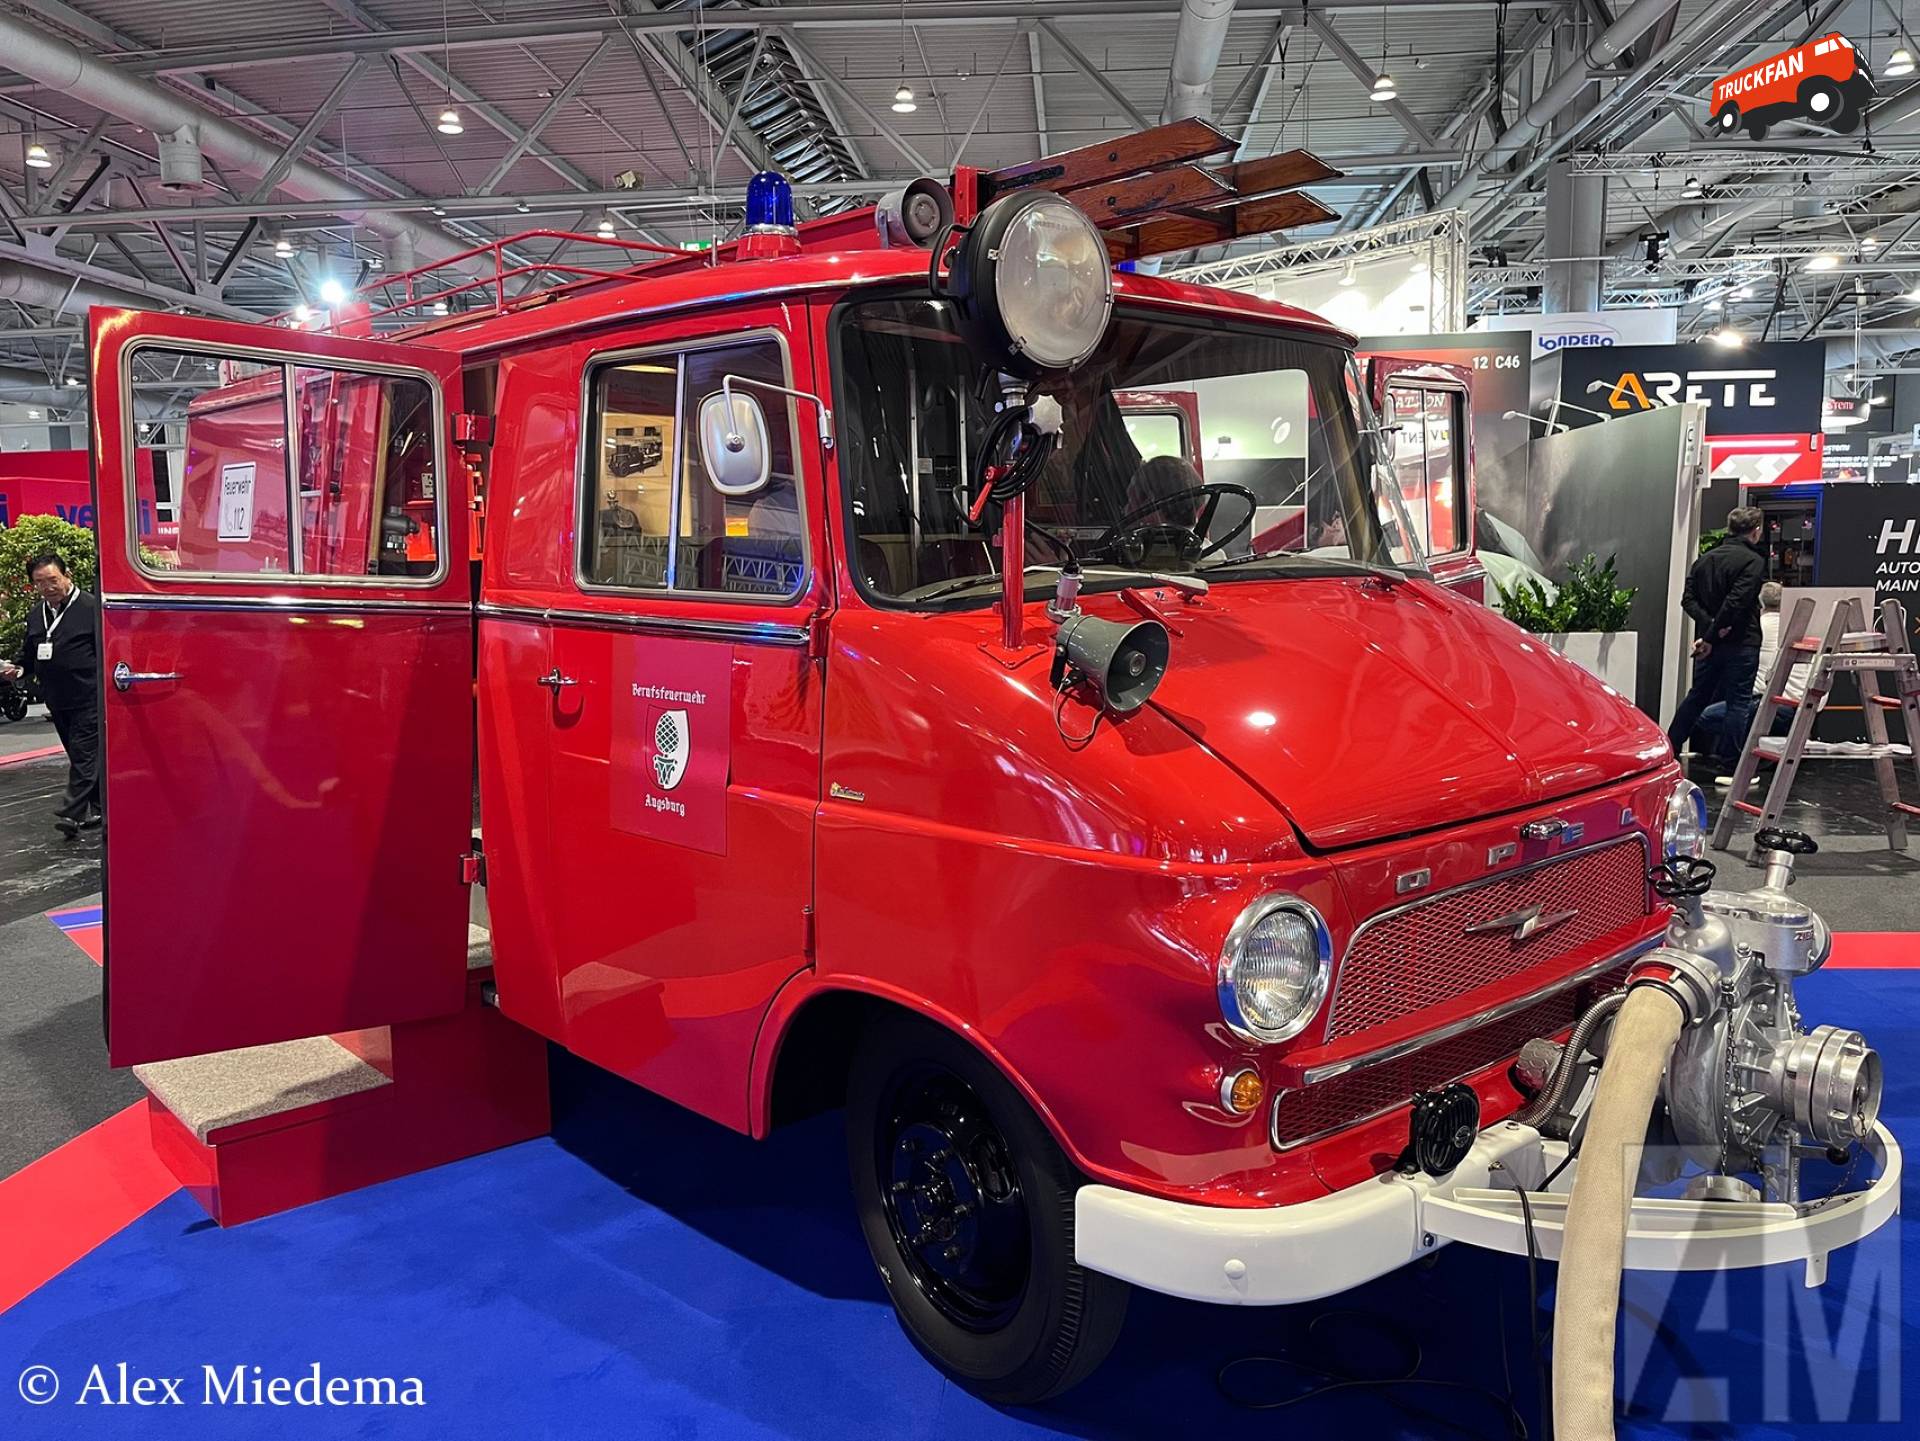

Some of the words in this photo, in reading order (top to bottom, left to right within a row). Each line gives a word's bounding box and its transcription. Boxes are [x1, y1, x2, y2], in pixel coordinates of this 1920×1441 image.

[1538, 334, 1614, 350] LONDERO
[1472, 356, 1488, 369] 12
[1495, 355, 1520, 369] C46
[1608, 370, 1776, 410] ARETE
[233, 507, 245, 530] 112
[1876, 519, 1920, 554] H
[1876, 579, 1919, 592] MAIN
[632, 683, 707, 705] Berufsfeuerwehr
[645, 794, 685, 817] Augsburg
